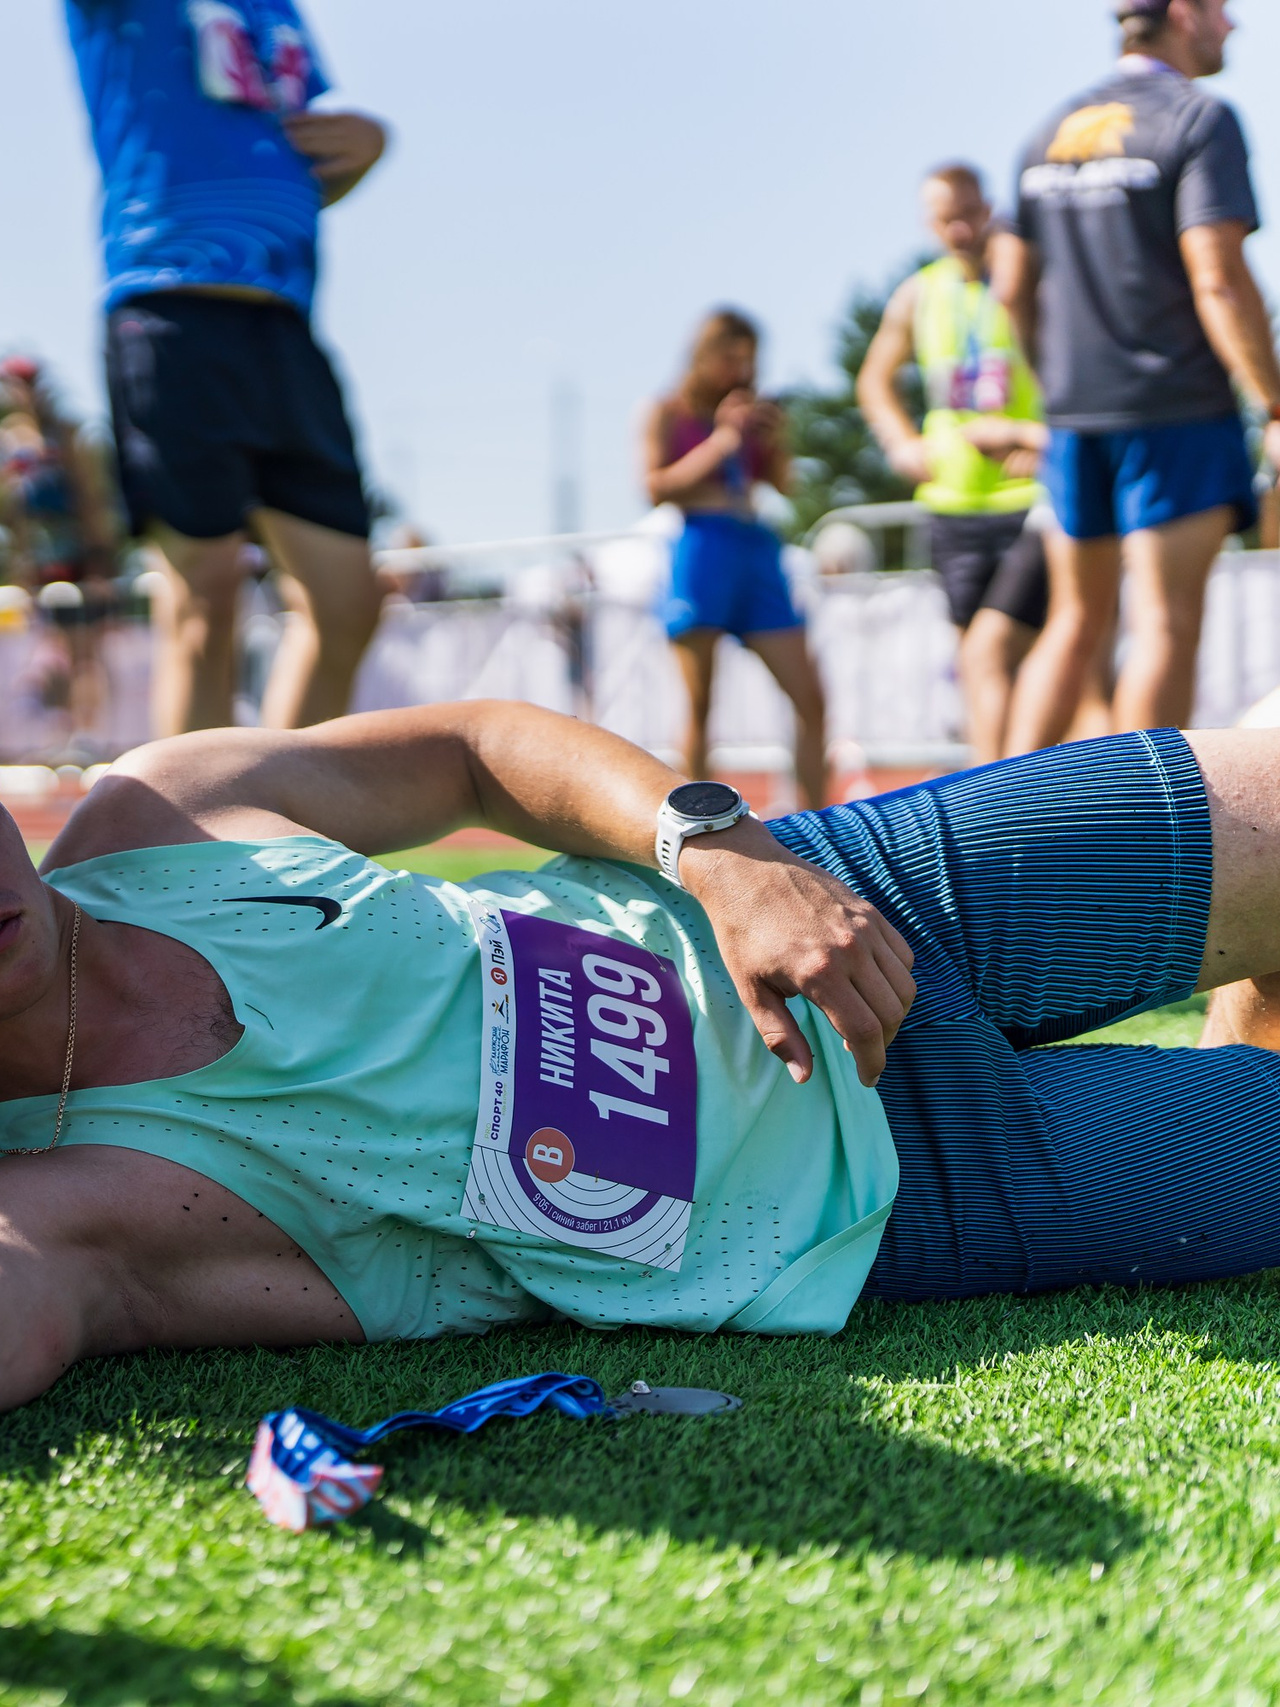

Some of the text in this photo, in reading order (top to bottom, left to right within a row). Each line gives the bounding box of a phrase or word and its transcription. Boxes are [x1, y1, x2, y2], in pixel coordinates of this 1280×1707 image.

[489, 939, 506, 965] Пэй
[538, 968, 575, 1089] НИКИТА
[582, 953, 670, 1126] 1499
[500, 1029, 510, 1074] МАРАФОН
[484, 1122, 492, 1139] PRO
[490, 1081, 504, 1141] СПОРТ 40
[532, 1193, 633, 1232] 9:05 синий забег 21.1 км
